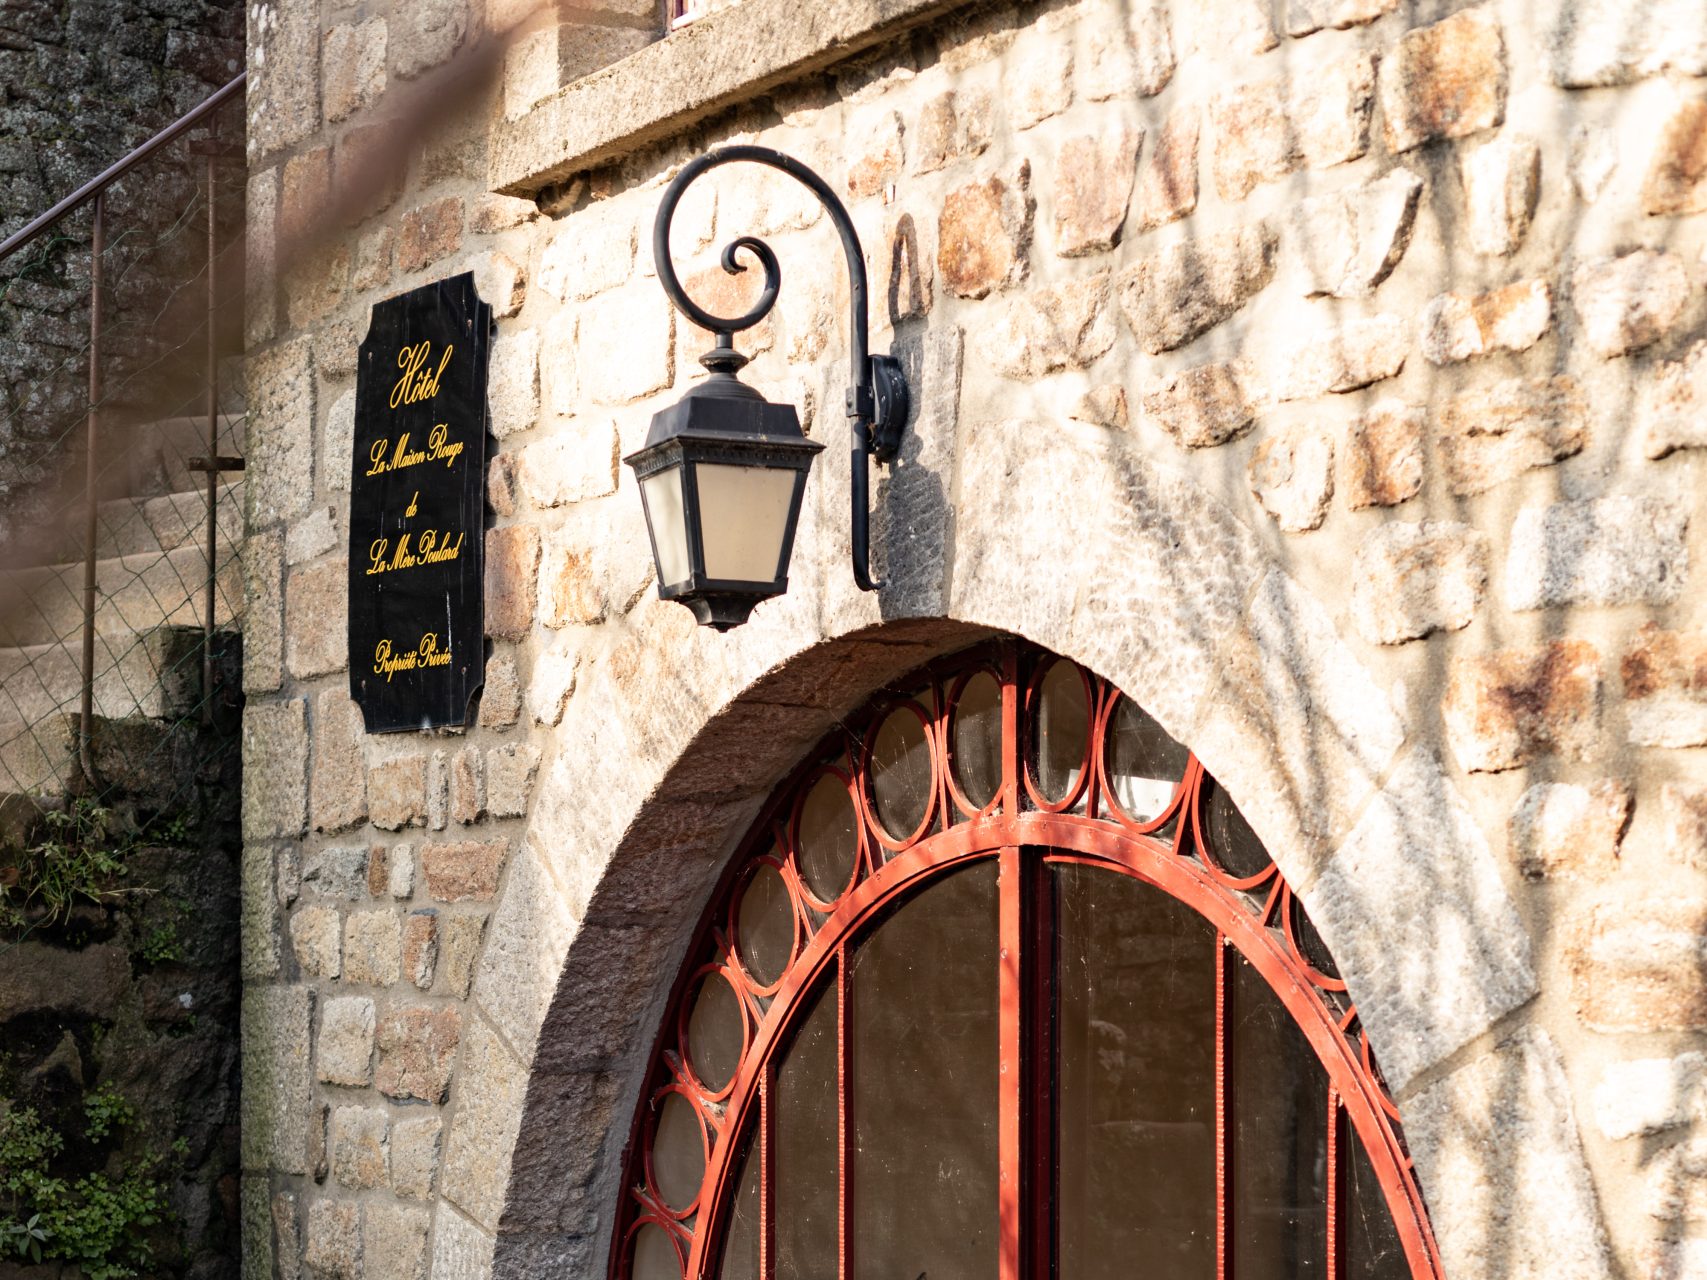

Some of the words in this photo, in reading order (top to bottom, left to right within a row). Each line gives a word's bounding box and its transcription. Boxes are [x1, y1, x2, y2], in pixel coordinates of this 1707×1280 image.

[390, 340, 453, 409] Hôtel
[366, 438, 388, 477] La
[386, 432, 425, 471] Maison
[427, 423, 464, 468] Rouge
[405, 491, 419, 517] de
[366, 538, 388, 576] La
[387, 533, 416, 571] Mère
[417, 529, 464, 566] Poulard
[373, 639, 417, 683] Propriété
[417, 632, 452, 668] Privée
